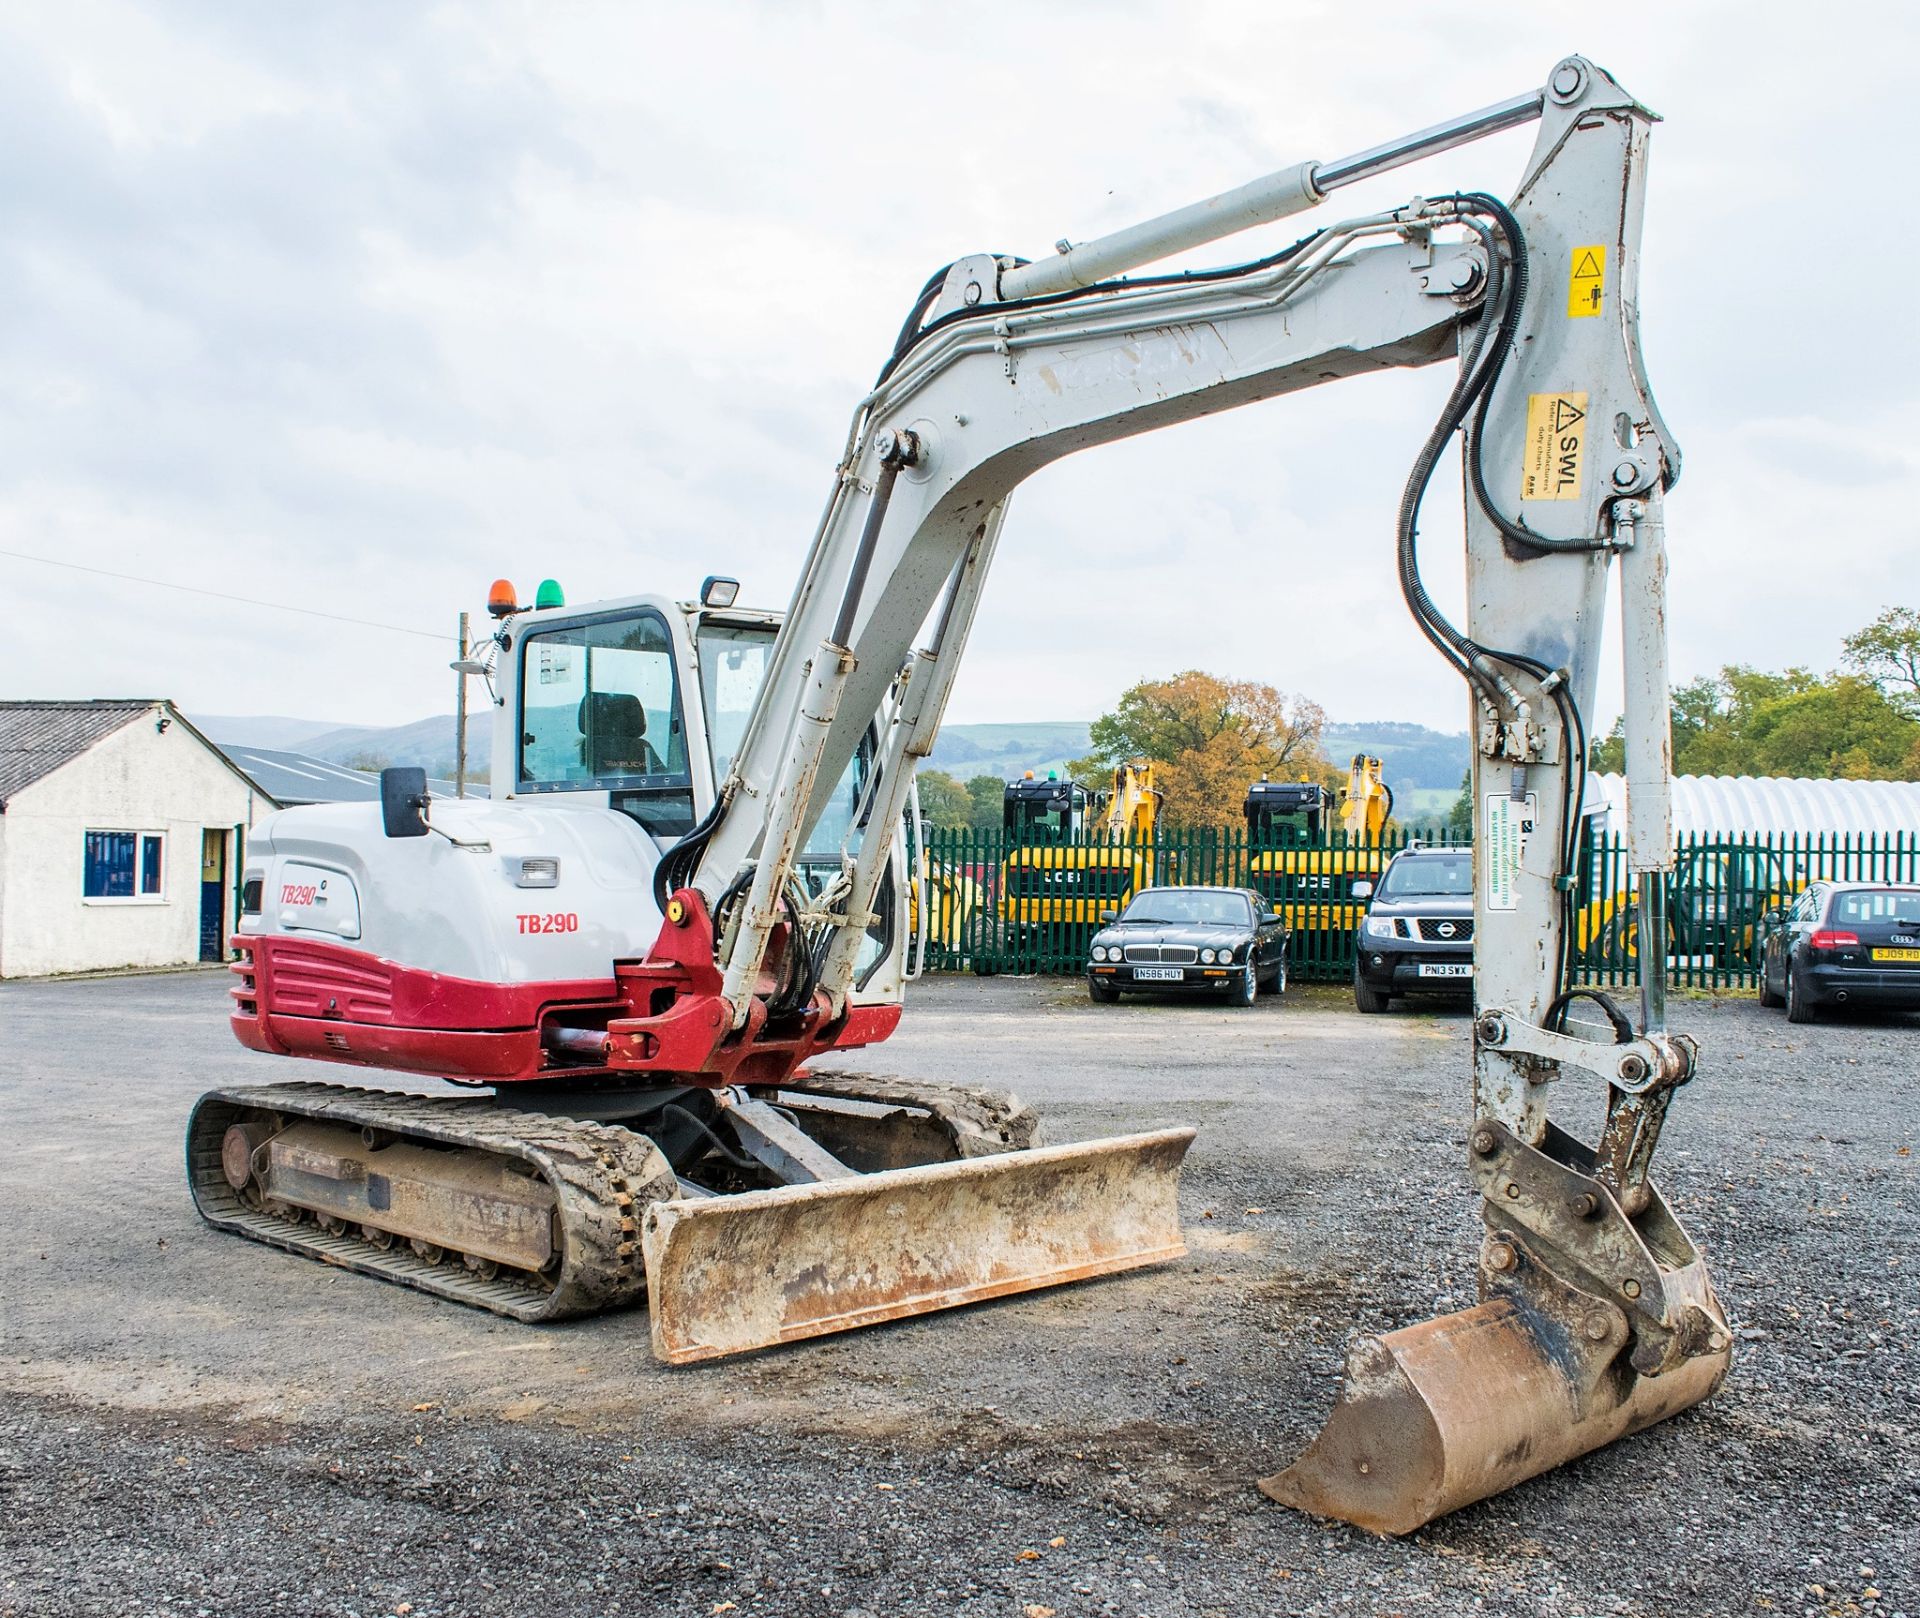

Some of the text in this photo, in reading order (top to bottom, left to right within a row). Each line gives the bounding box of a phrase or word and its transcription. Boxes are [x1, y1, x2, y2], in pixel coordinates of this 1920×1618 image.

[1558, 437, 1578, 493] SWL
[1491, 811, 1498, 821] NO
[281, 885, 316, 905] TB290
[516, 913, 578, 934] TB290
[1877, 949, 1904, 958] SJ09
[1140, 969, 1182, 979] N586 HUY
[1425, 966, 1467, 975] PN13 SWX
